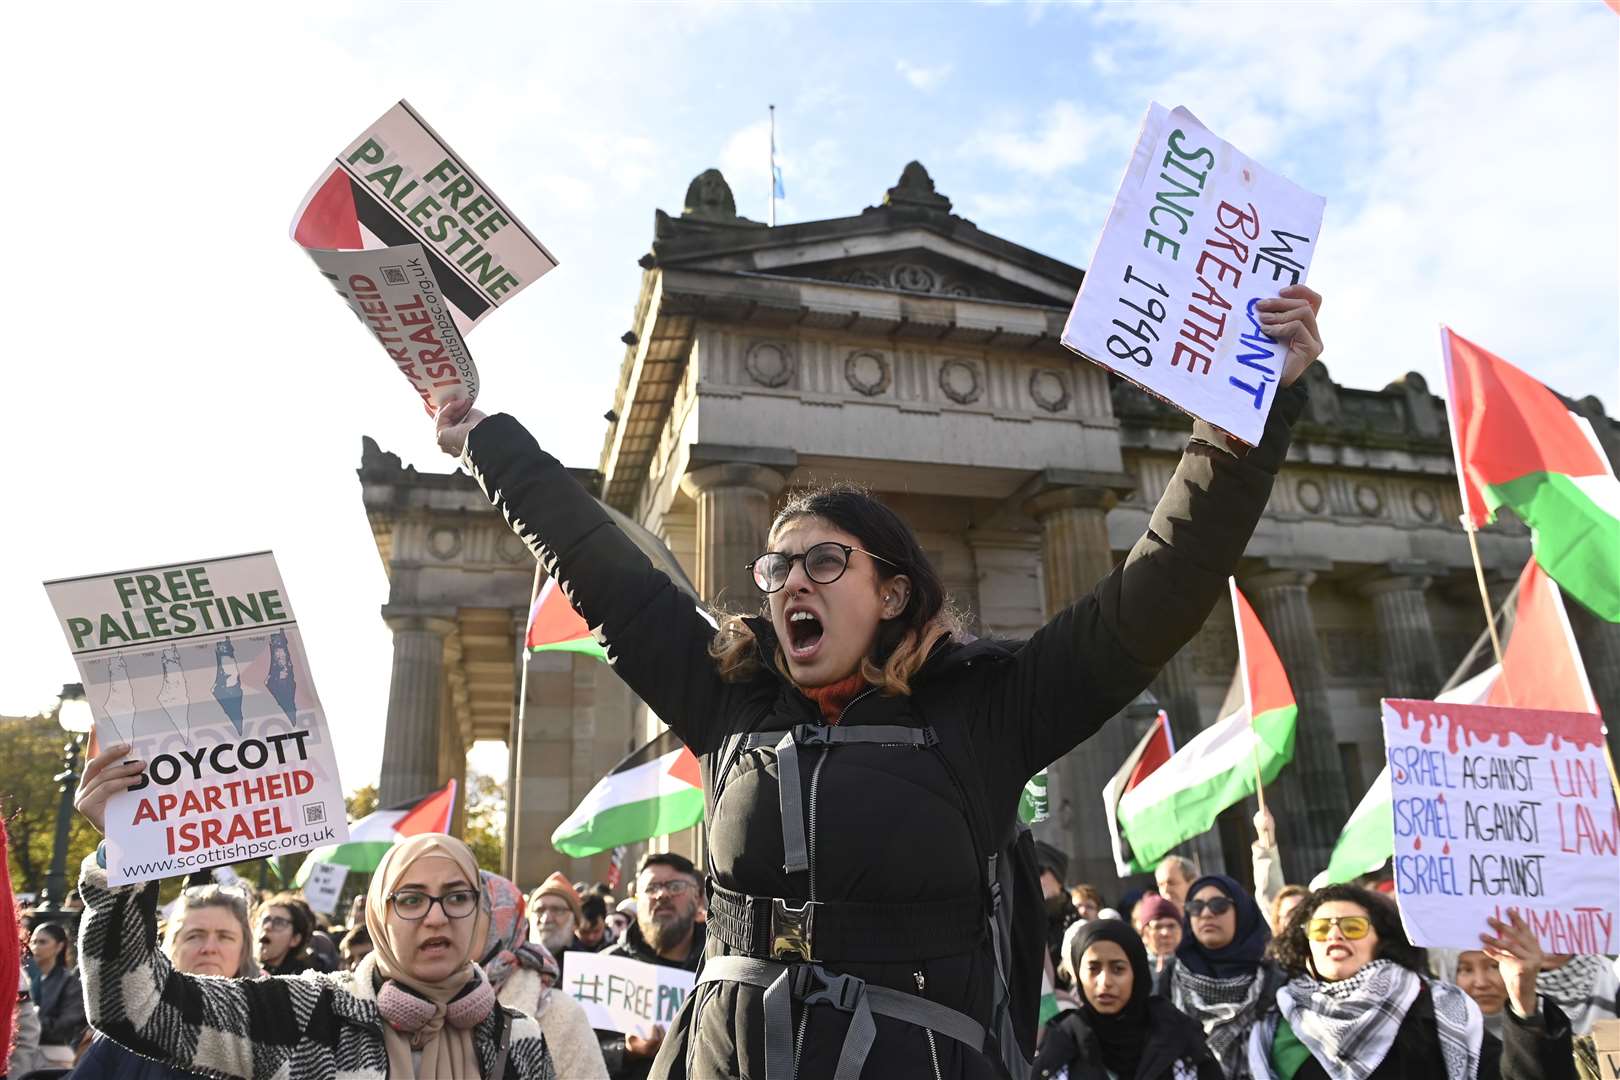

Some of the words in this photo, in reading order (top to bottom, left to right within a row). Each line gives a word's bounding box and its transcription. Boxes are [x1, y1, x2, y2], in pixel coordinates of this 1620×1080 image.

[346, 137, 519, 300] PALESTINE
[422, 158, 509, 241] FREE
[1144, 129, 1214, 261] SINCE
[1171, 200, 1259, 375] BREATHE
[1252, 229, 1310, 287] WE
[349, 274, 438, 411] ARTHEID
[395, 294, 461, 387] ISRAEL
[1106, 265, 1170, 367] 1948
[113, 567, 214, 608] FREE
[67, 590, 287, 649] PALESTINE
[132, 770, 314, 825] APARTHEID
[1389, 746, 1456, 788] ISRAEL
[1462, 755, 1539, 791] AGAINST
[1551, 758, 1598, 798] UN
[123, 826, 336, 878] www.scottishpsc.org.uk
[166, 806, 292, 855] ISRAEL
[1393, 797, 1458, 840] ISRAEL
[1465, 800, 1542, 843] AGAINST
[1558, 802, 1618, 856] LAW
[1395, 854, 1463, 896] ISRAEL
[1469, 854, 1546, 897] AGAINST
[1496, 905, 1612, 956] MANITY
